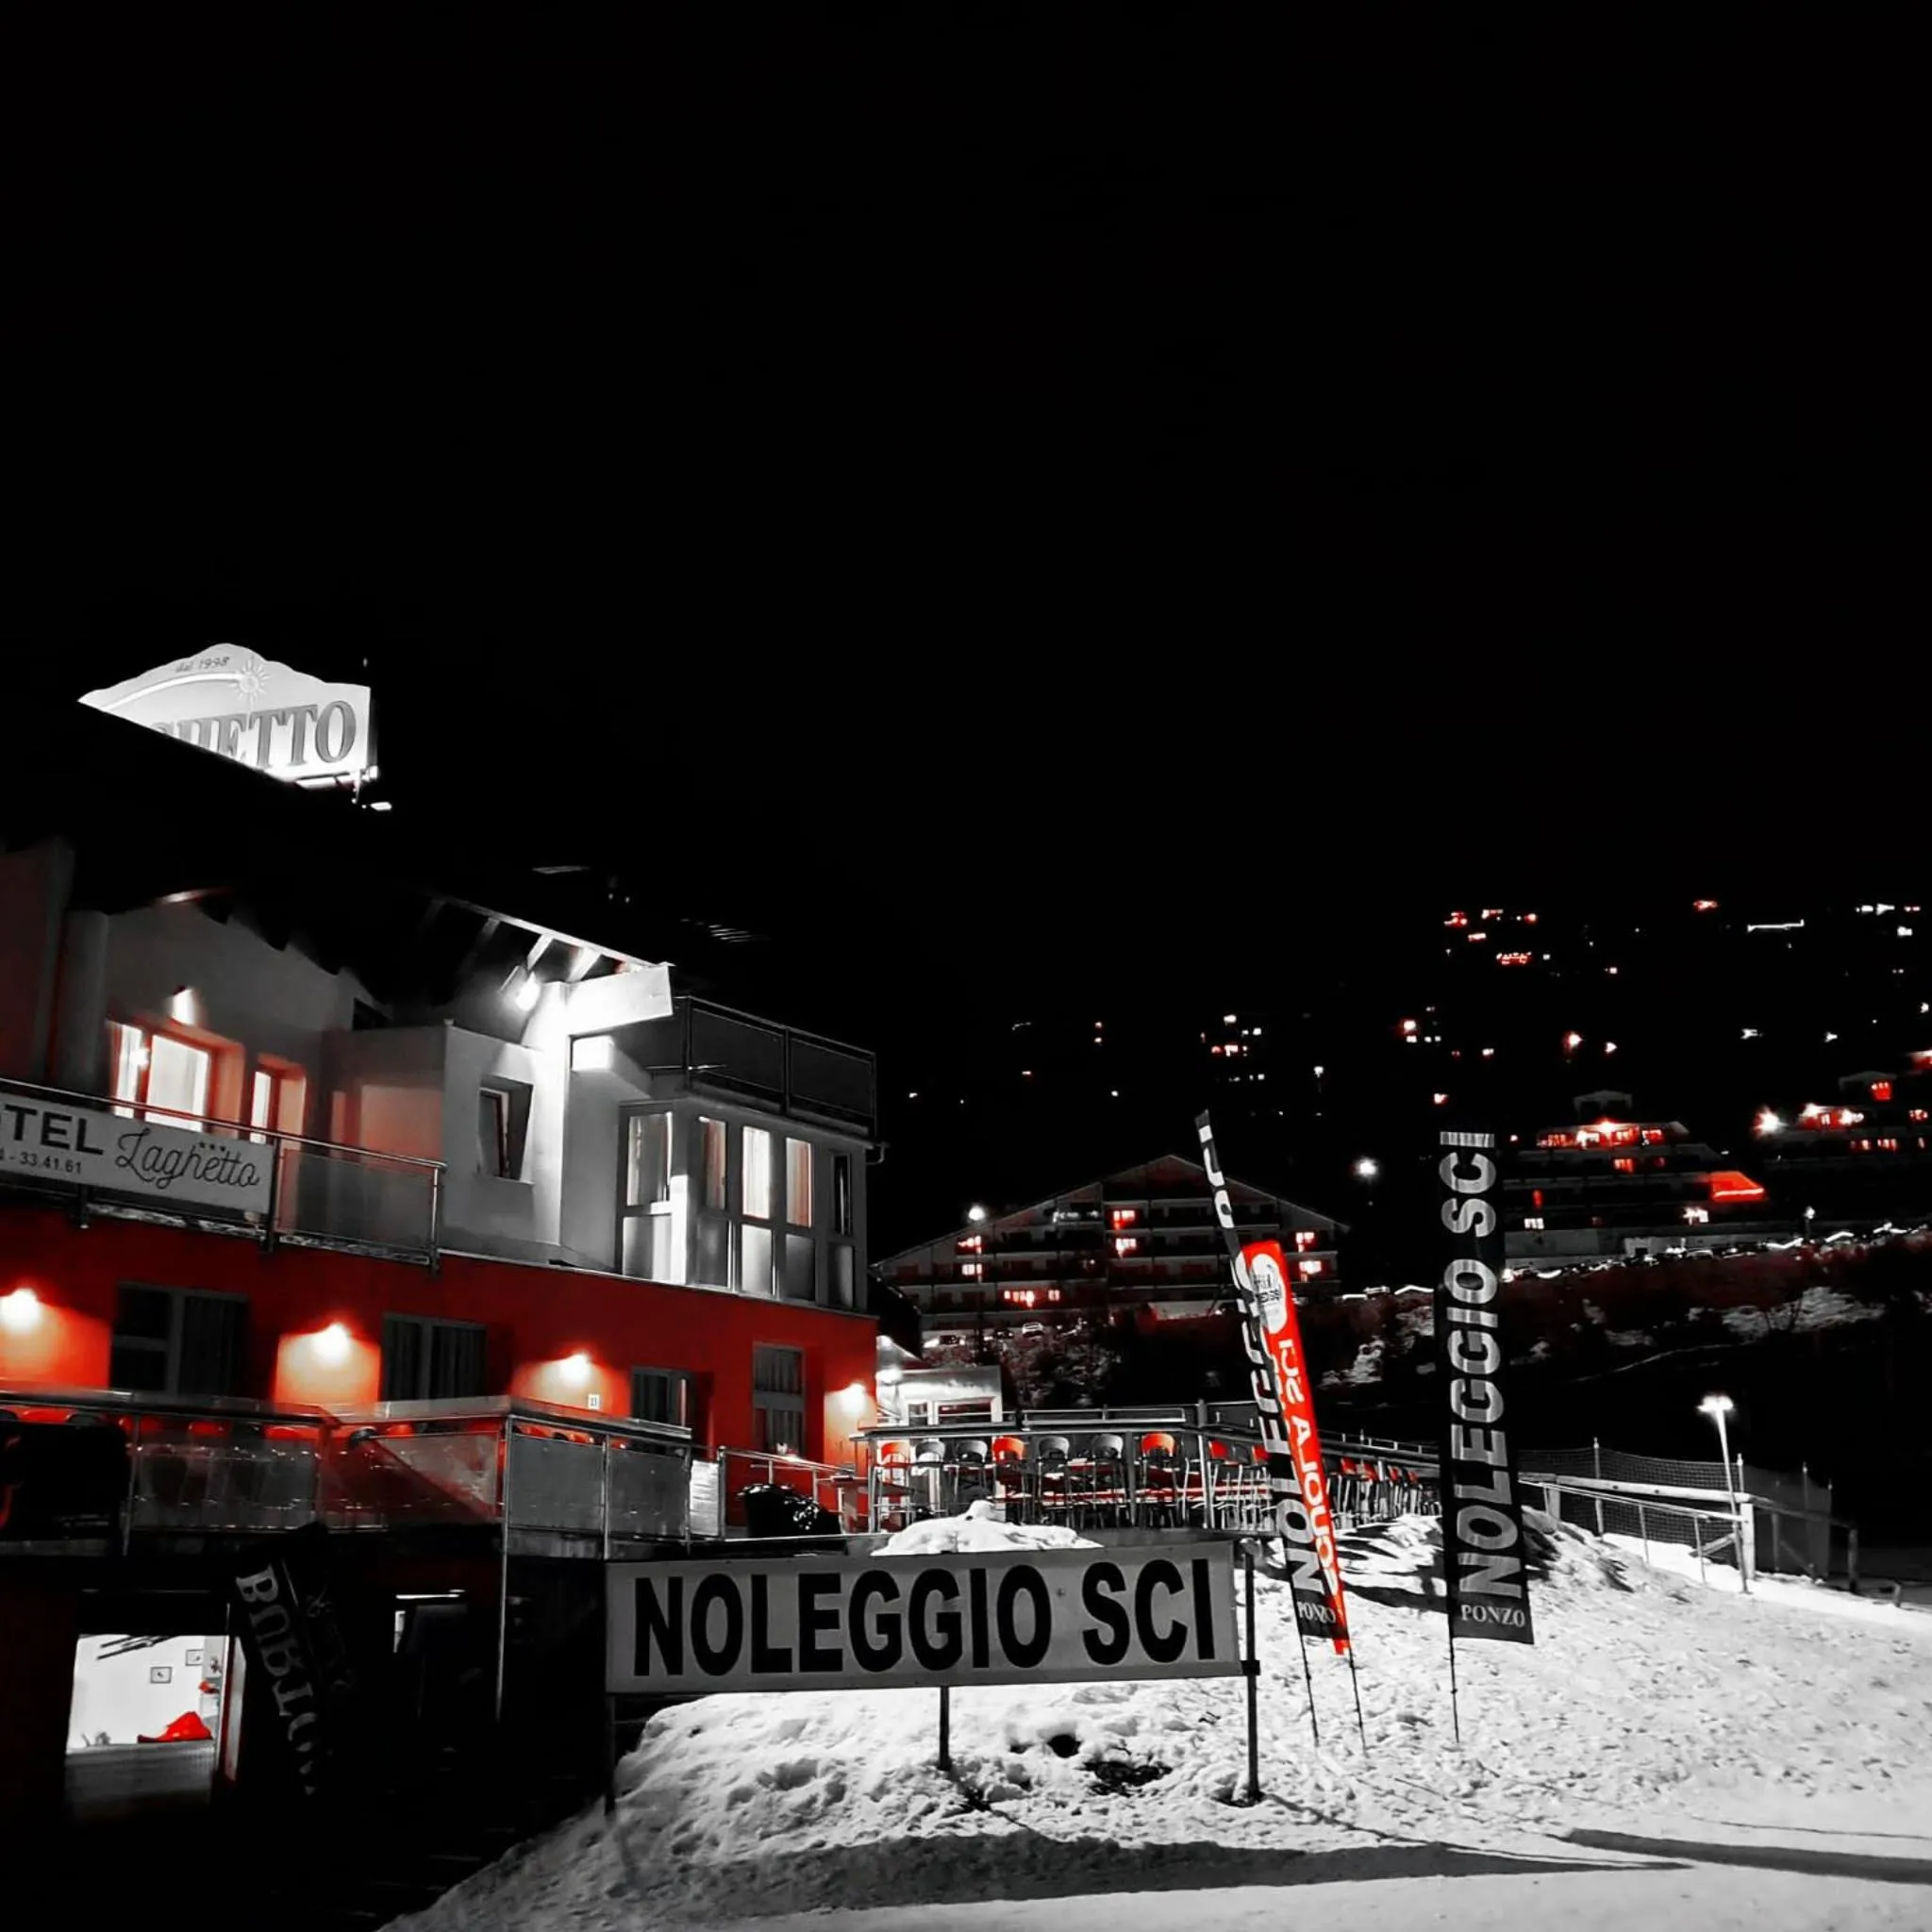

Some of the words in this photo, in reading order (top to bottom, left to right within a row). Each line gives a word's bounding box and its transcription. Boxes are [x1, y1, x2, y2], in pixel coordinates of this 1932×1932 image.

[0, 1103, 104, 1156] TEL
[115, 1128, 260, 1190] Laghetto
[1439, 1131, 1497, 1238] SCI
[1443, 1257, 1524, 1599] NOLEGGIO
[634, 1564, 1052, 1677] NOLEGGIO
[1082, 1558, 1216, 1666] SCI
[1460, 1604, 1525, 1628] PONZO
